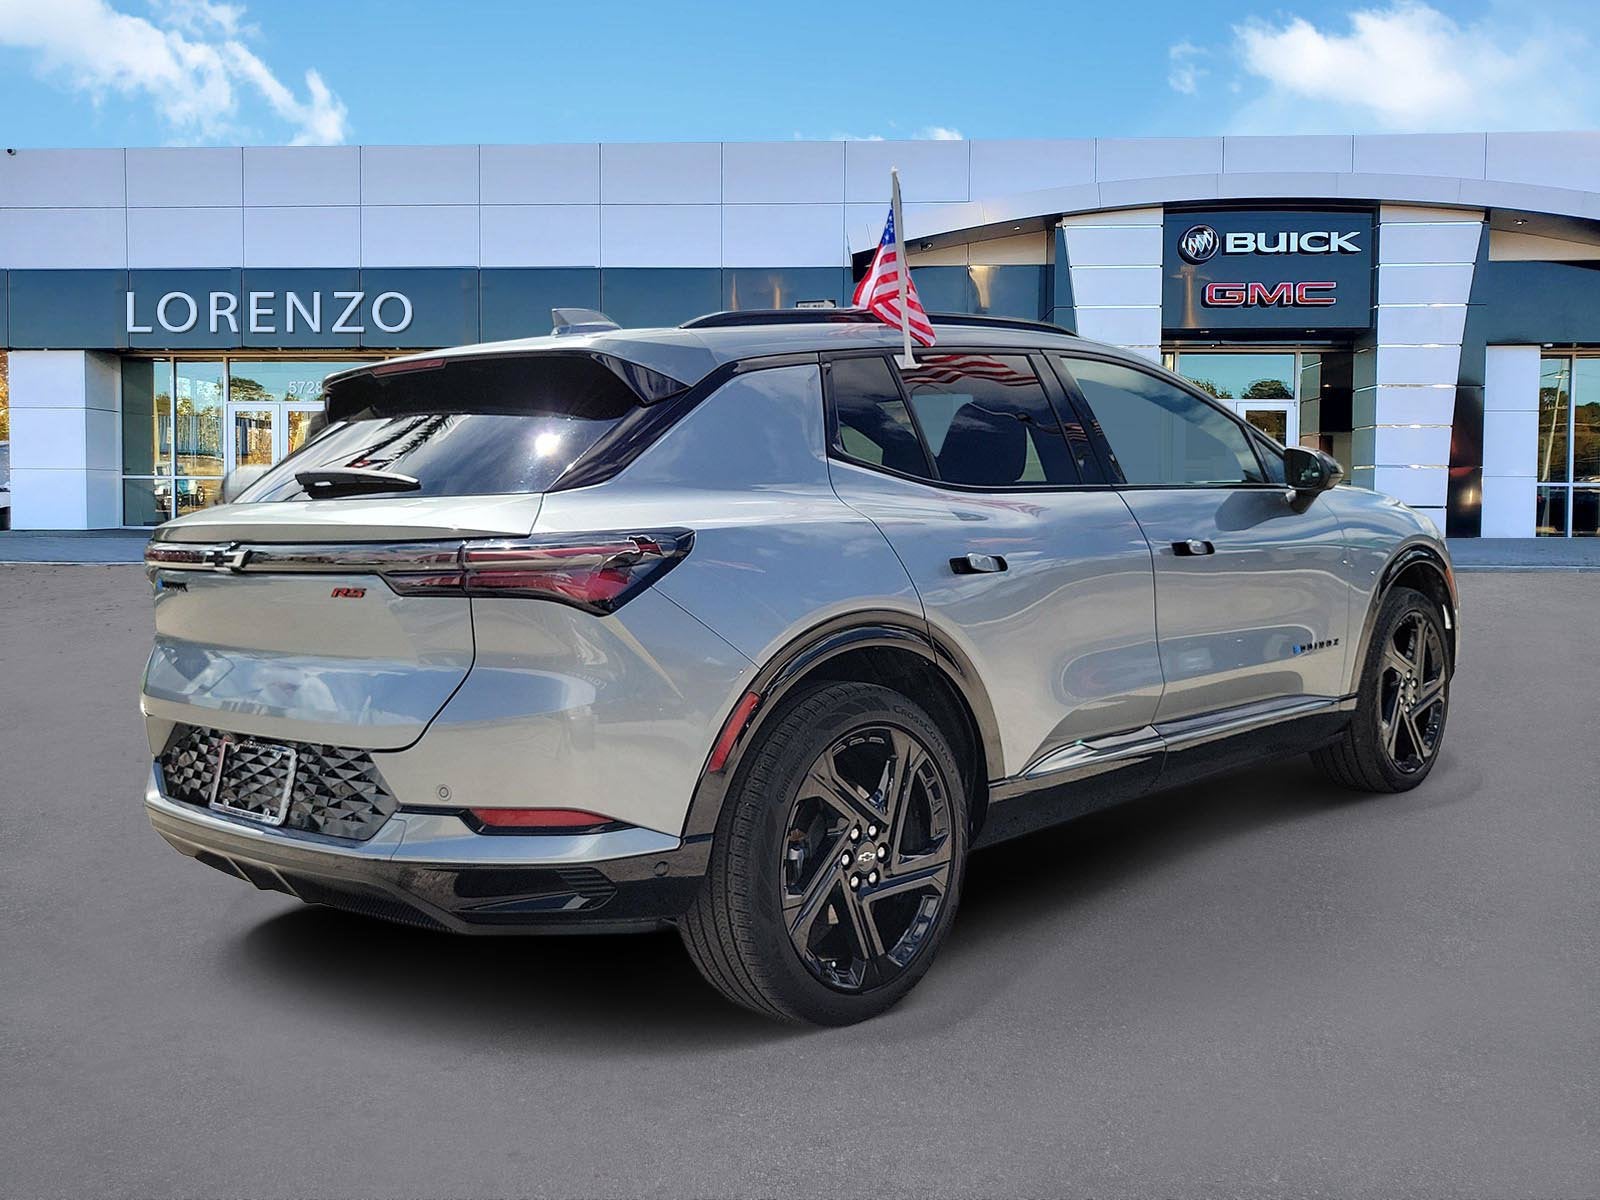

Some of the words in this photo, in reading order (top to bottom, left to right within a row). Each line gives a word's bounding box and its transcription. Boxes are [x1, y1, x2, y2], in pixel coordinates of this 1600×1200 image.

[1226, 231, 1361, 253] BUICK
[1205, 281, 1337, 306] GMC
[126, 291, 414, 333] LORENZO
[331, 587, 367, 598] RS
